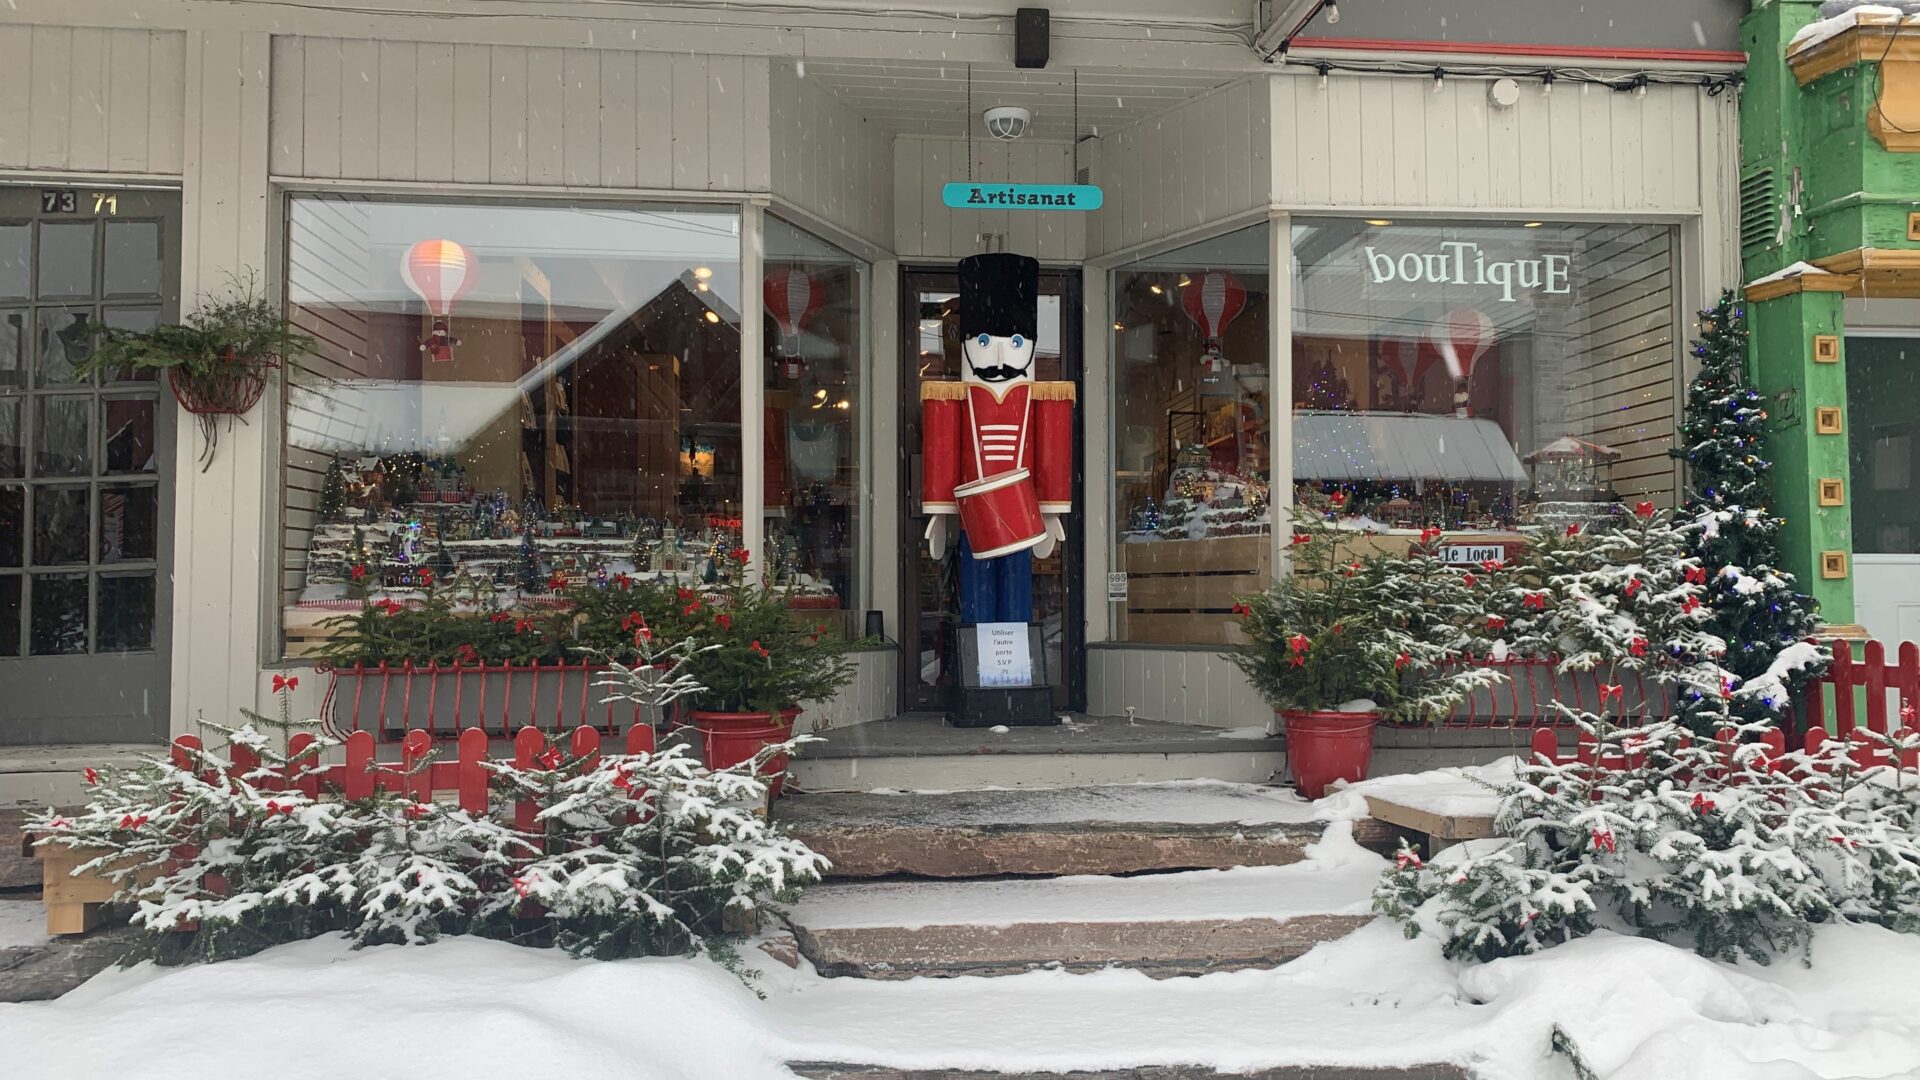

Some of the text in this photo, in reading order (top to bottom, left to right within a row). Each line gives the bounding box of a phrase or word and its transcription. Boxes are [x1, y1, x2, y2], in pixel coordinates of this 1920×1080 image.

[43, 192, 75, 212] 73
[92, 192, 117, 215] 71
[967, 188, 1076, 206] Artisanat
[982, 233, 1005, 252] 71
[1466, 547, 1499, 562] Local
